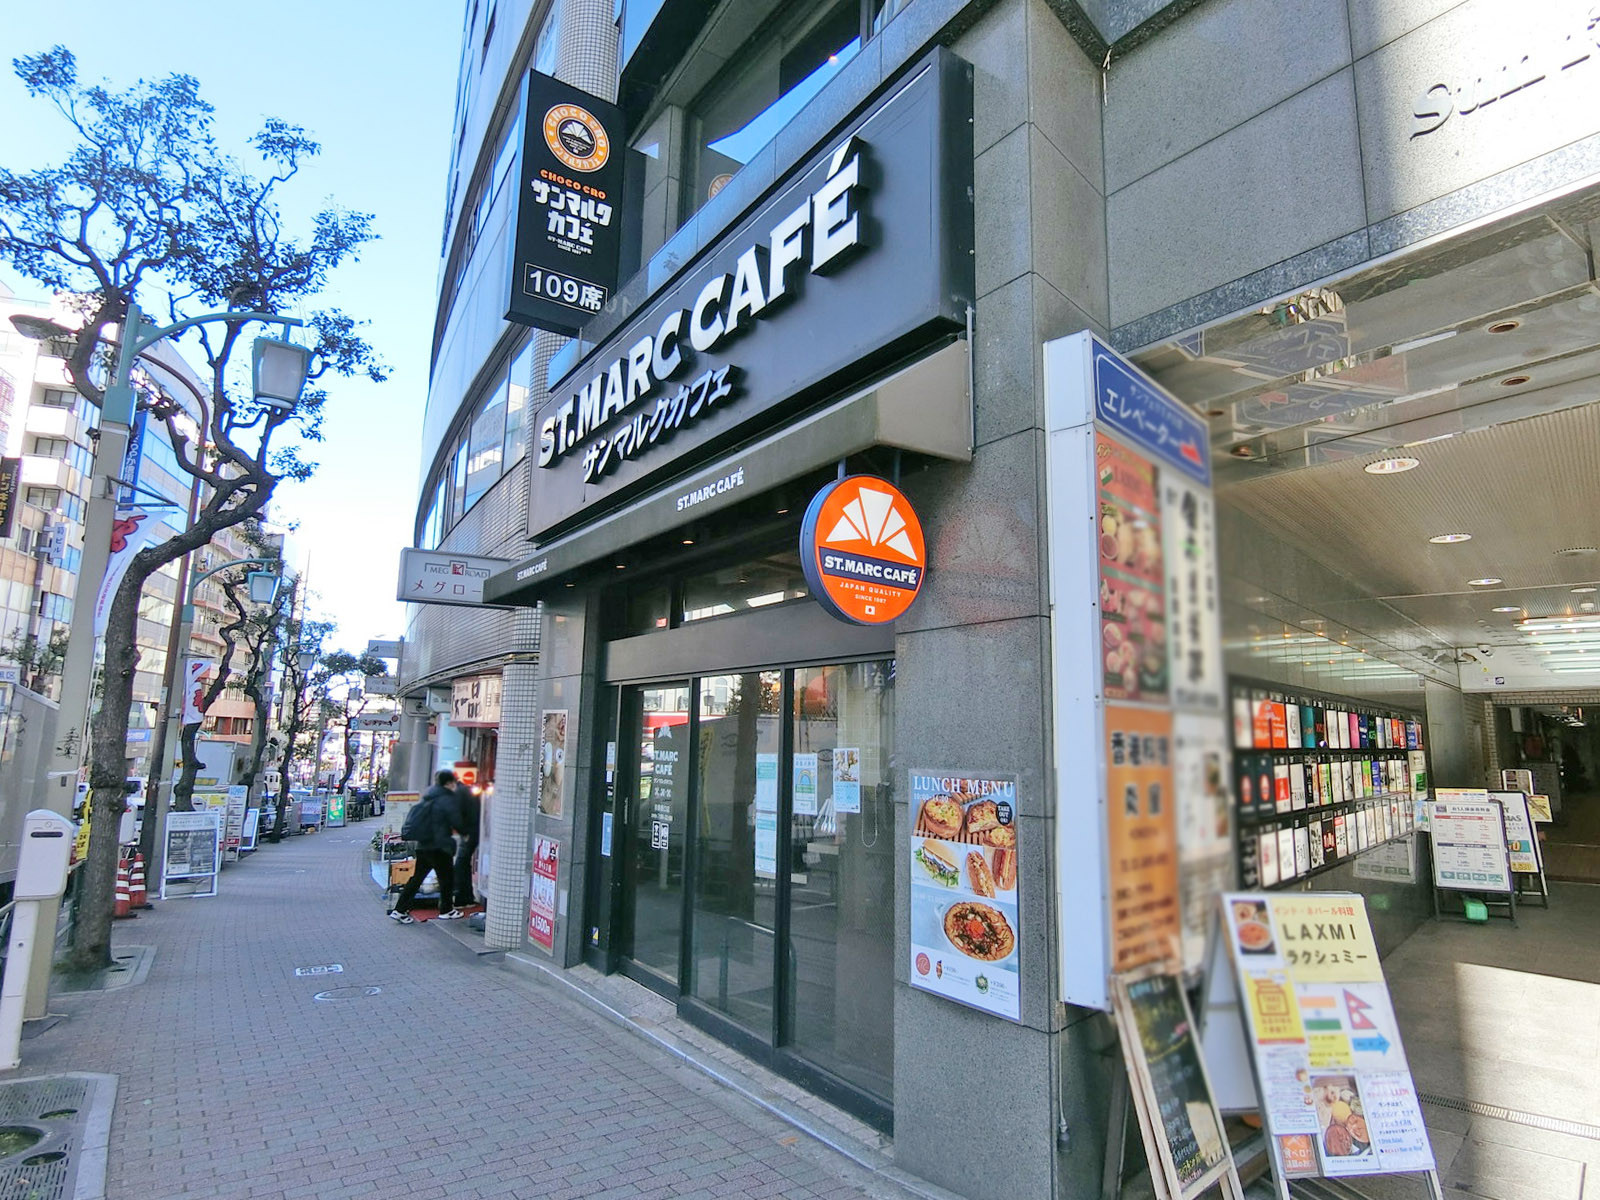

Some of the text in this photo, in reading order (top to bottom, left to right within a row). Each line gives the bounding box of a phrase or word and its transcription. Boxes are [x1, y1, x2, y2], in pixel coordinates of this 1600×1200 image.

[540, 169, 607, 200] CHOCO CRO
[531, 179, 613, 227] サンマルク
[547, 210, 594, 246] カフェ
[530, 270, 602, 312] 109席
[539, 134, 861, 469] ST.MARC CAFÉ
[582, 364, 735, 484] サンマルクカフェ
[676, 466, 744, 512] ST.MARC CAFÉ
[824, 555, 917, 585] ST.MARC CAFÉ
[840, 582, 902, 598] JAPAN QUALITY
[855, 593, 873, 602] SINCE
[654, 761, 673, 776] CAFÉ
[913, 775, 1014, 798] LUNCH MENU
[1282, 923, 1357, 941] LAXMI
[1286, 948, 1368, 966] ラクシュミー
